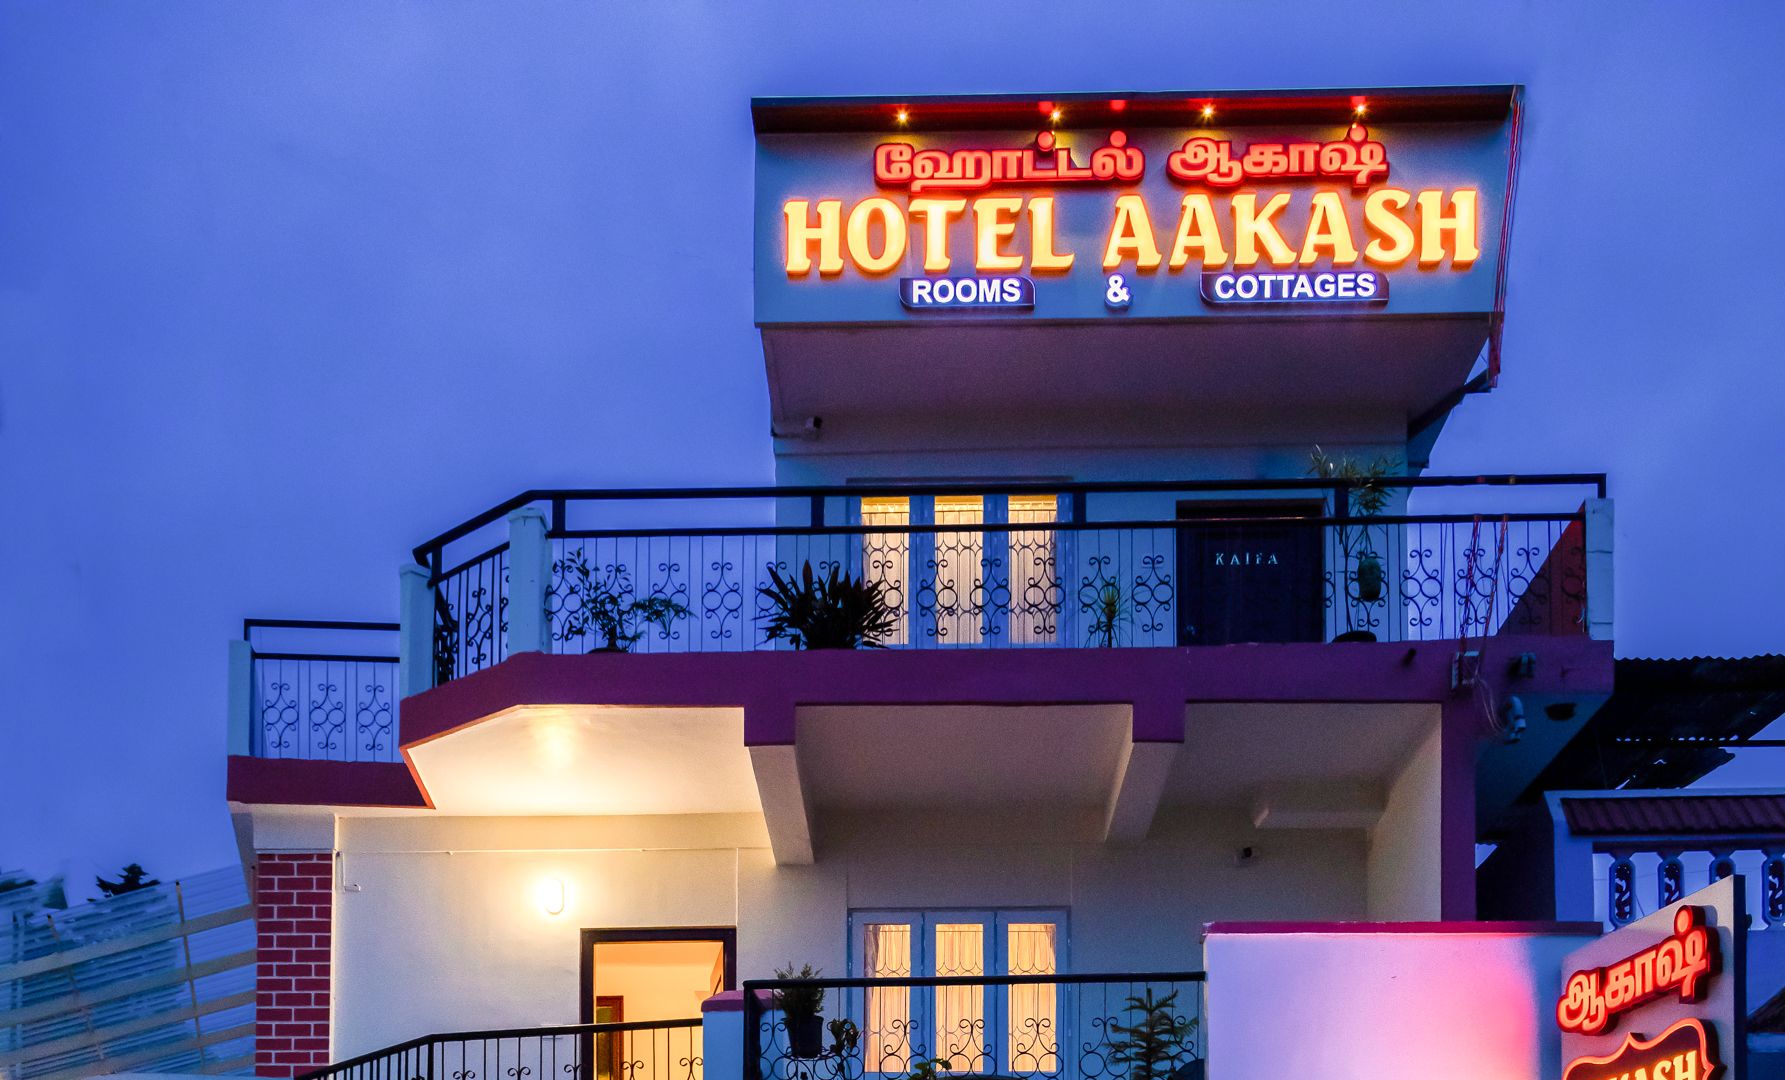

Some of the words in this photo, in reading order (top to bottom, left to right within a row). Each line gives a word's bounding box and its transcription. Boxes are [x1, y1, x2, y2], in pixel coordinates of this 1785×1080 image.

[874, 130, 1145, 193] ஹோட்டல்
[1168, 123, 1388, 186] ஆகாஷ்
[783, 196, 1076, 274] HOTEL
[1102, 188, 1480, 269] AAKASH
[911, 278, 1022, 304] ROOMS
[1106, 274, 1131, 303] &
[1214, 272, 1377, 300] COTTAGES
[1557, 908, 1709, 1032] ஆகாஷ்
